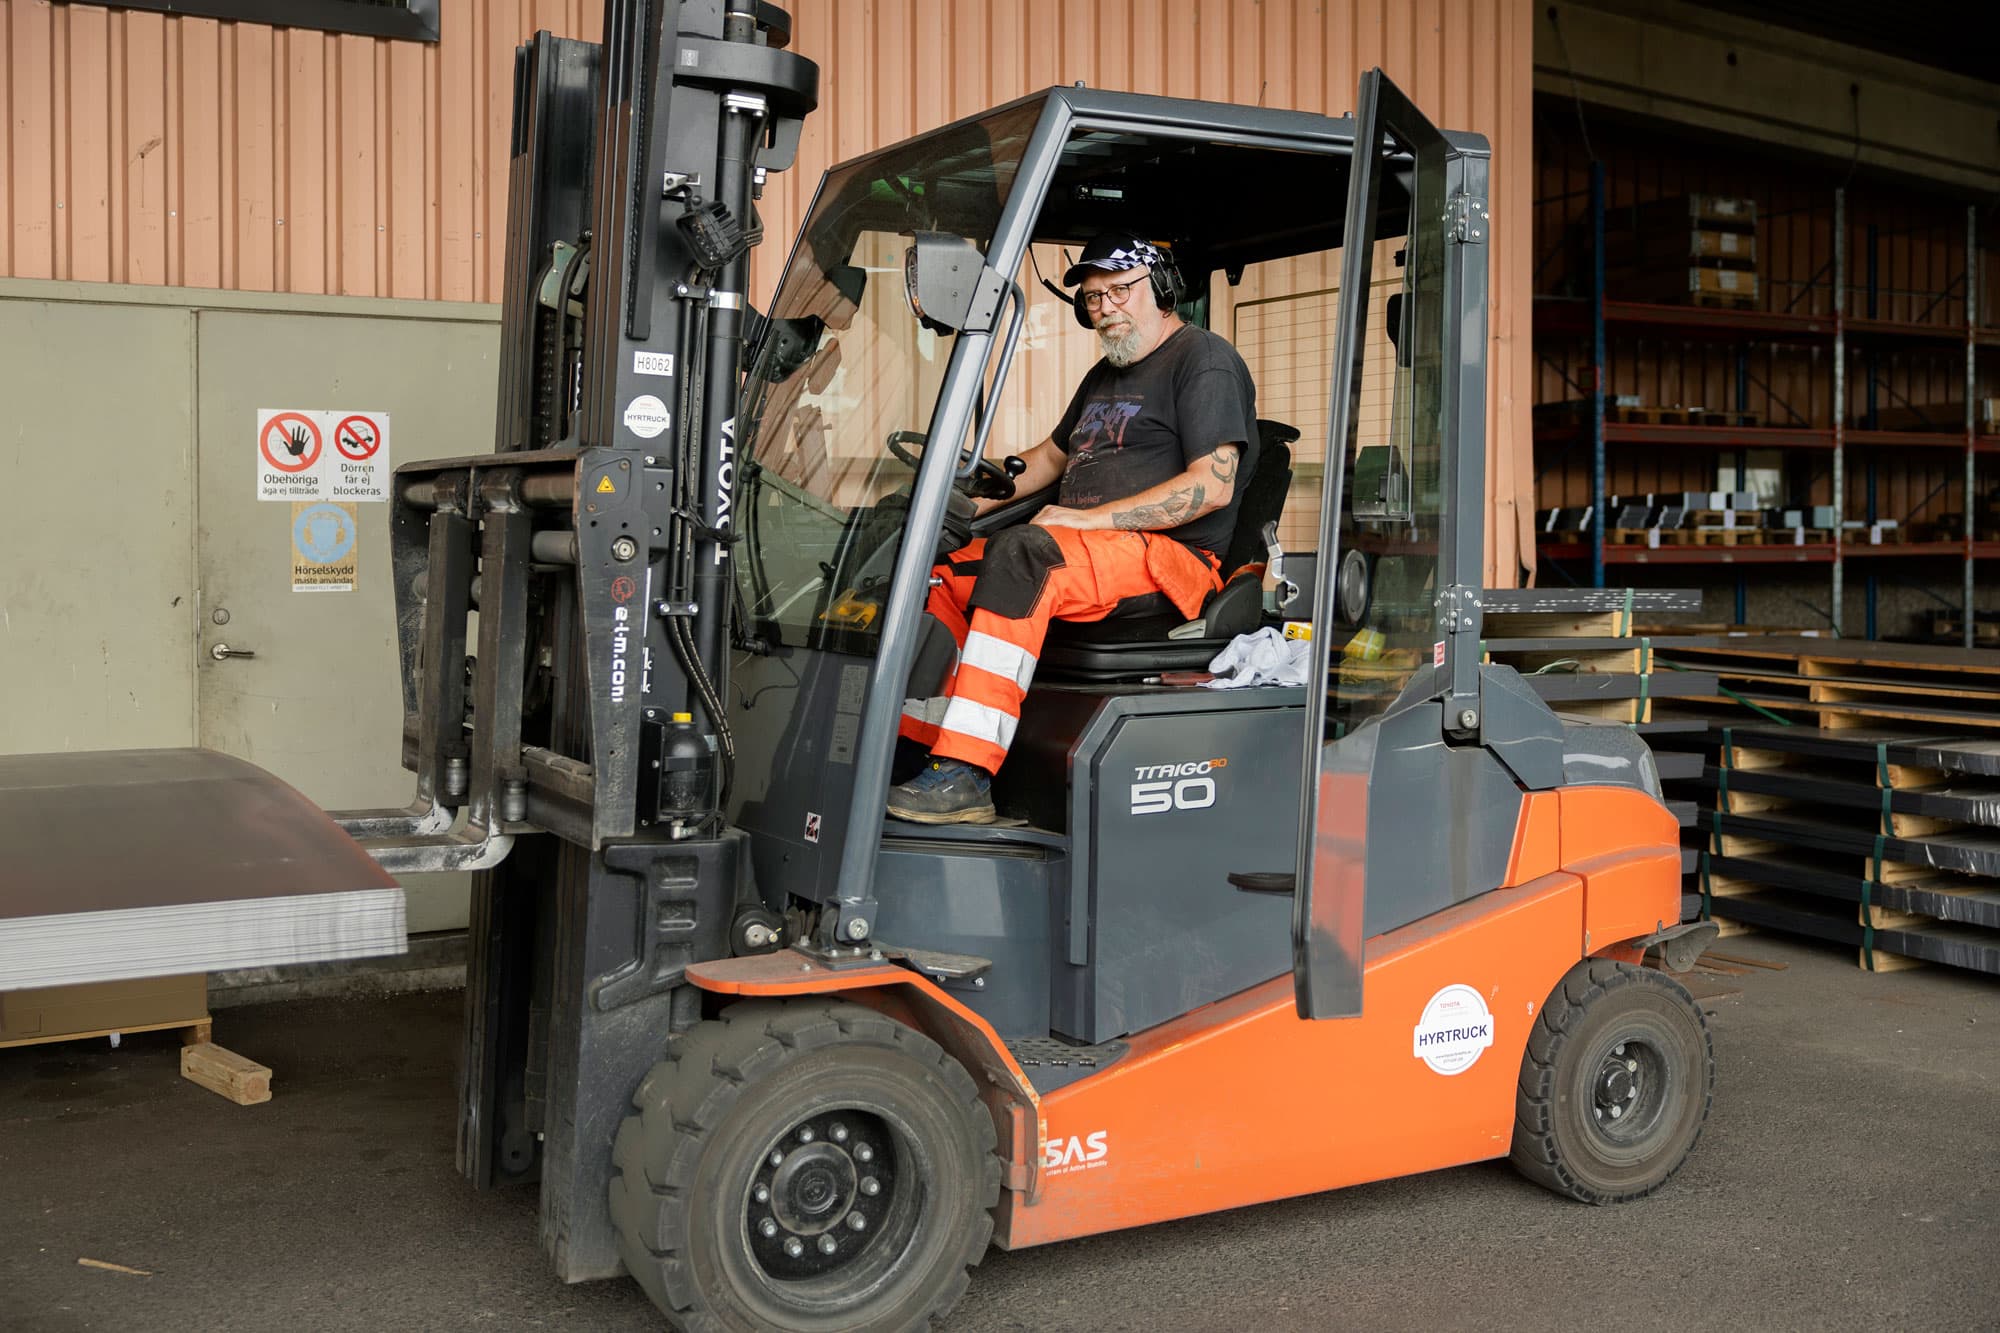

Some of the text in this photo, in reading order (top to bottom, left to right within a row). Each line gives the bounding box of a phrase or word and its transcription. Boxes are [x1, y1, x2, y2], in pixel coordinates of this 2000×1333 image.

[637, 356, 670, 372] H8062
[627, 414, 667, 423] HYRTRUCK
[264, 474, 318, 487] Obehöriga
[361, 476, 370, 486] ej
[333, 486, 381, 496] blockeras
[294, 565, 354, 577] Hörselskydd
[1131, 777, 1216, 815] 50
[1419, 1024, 1488, 1047] HYRTRUCK
[1046, 1130, 1108, 1168] SAS
